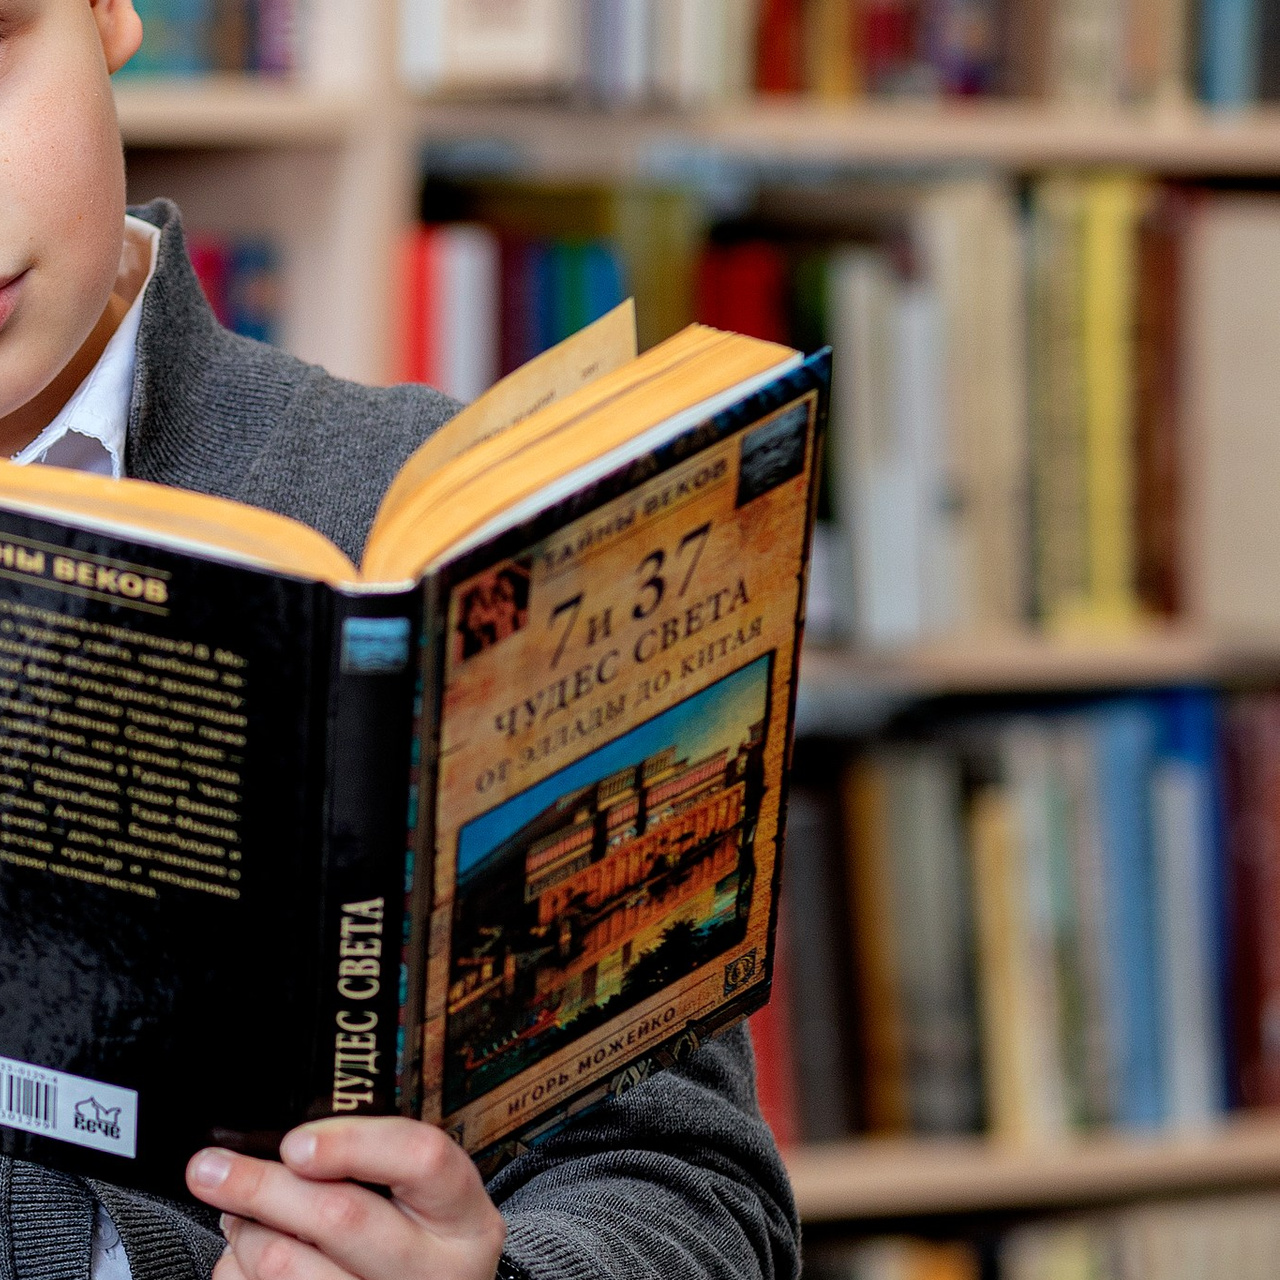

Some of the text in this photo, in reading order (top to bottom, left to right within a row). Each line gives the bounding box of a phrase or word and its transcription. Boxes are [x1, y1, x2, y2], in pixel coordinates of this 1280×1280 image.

[642, 458, 728, 518] ВЕКОВ
[53, 554, 169, 604] ВЕКОВ
[547, 591, 584, 668] 7
[634, 521, 713, 619] 37
[495, 577, 750, 737] ЧУДЕС СВЕТА
[633, 669, 671, 708] ДО
[680, 615, 763, 680] КИТАЯ
[332, 896, 385, 1111] ЧУДЕС СВЕТА
[508, 1006, 677, 1116] ИГОРЬ МОЖЕЙКО
